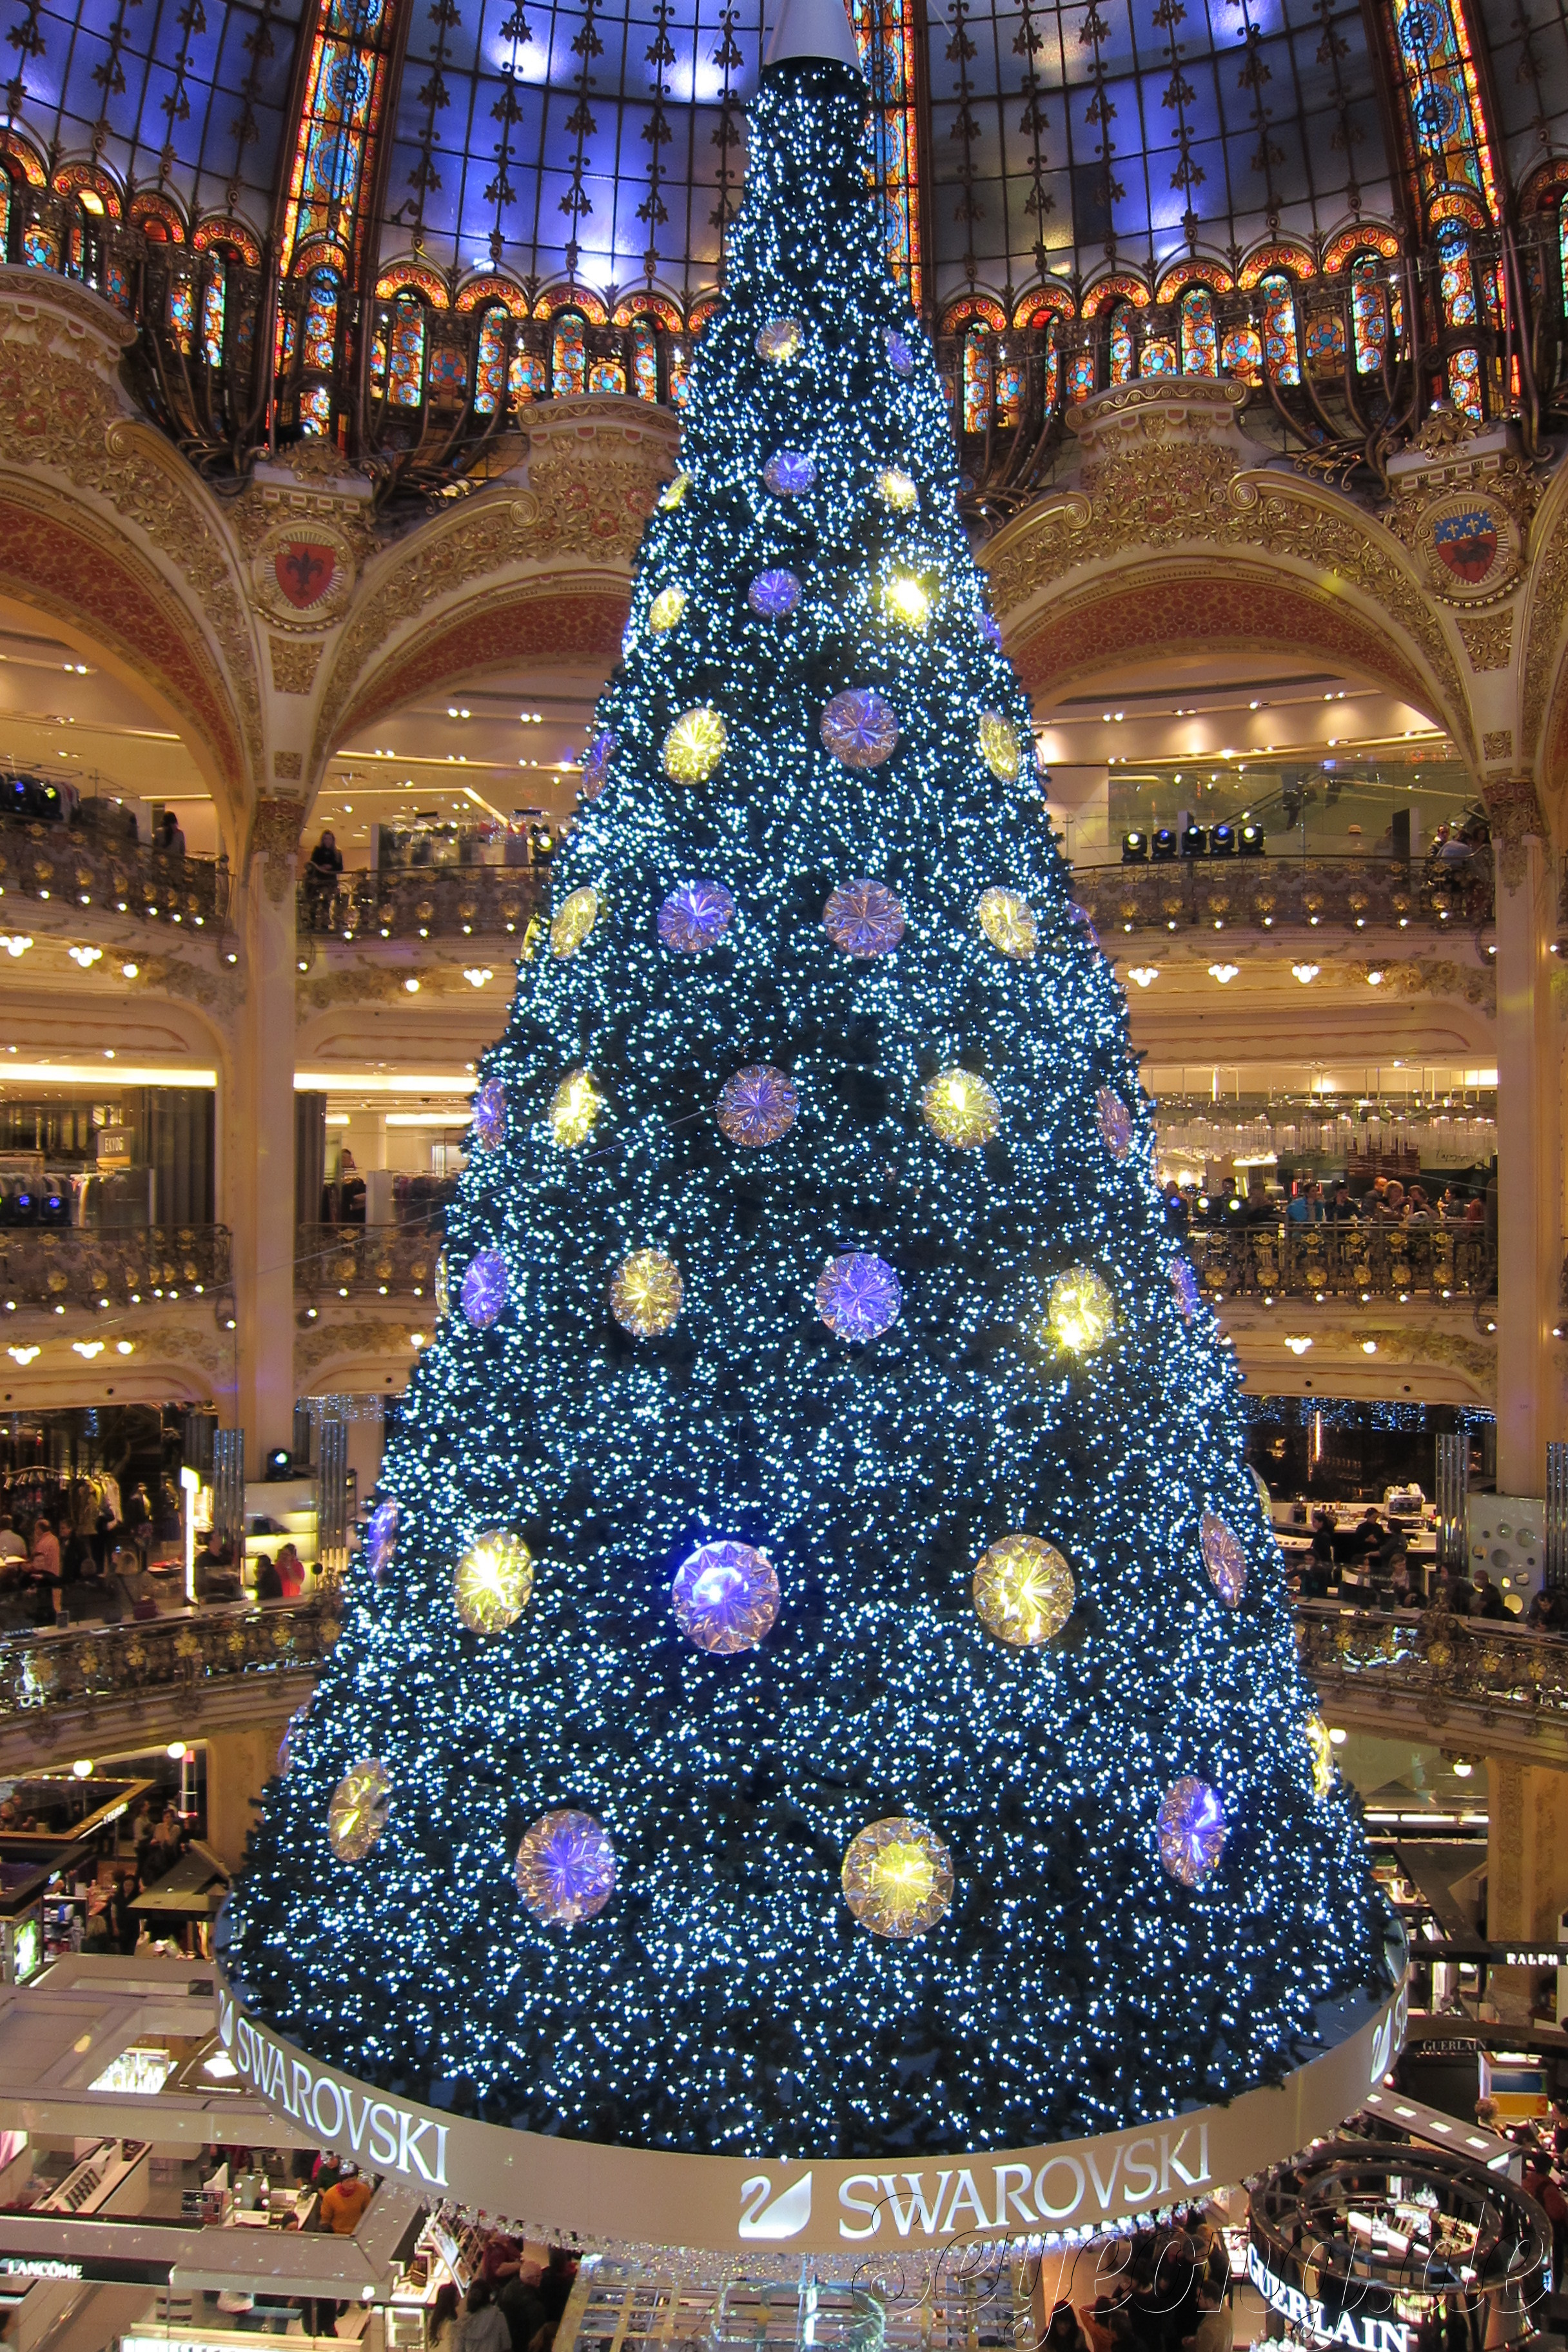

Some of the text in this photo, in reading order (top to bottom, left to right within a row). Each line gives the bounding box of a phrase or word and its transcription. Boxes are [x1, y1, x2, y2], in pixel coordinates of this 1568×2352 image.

[1506, 1952, 1558, 1966] RALPH
[1422, 2038, 1487, 2051] GUERLAIN
[236, 2017, 451, 2188] SWAROVSKI
[838, 2122, 1212, 2240] SWAROVSKI
[1247, 2242, 1411, 2352] GUERLAIN
